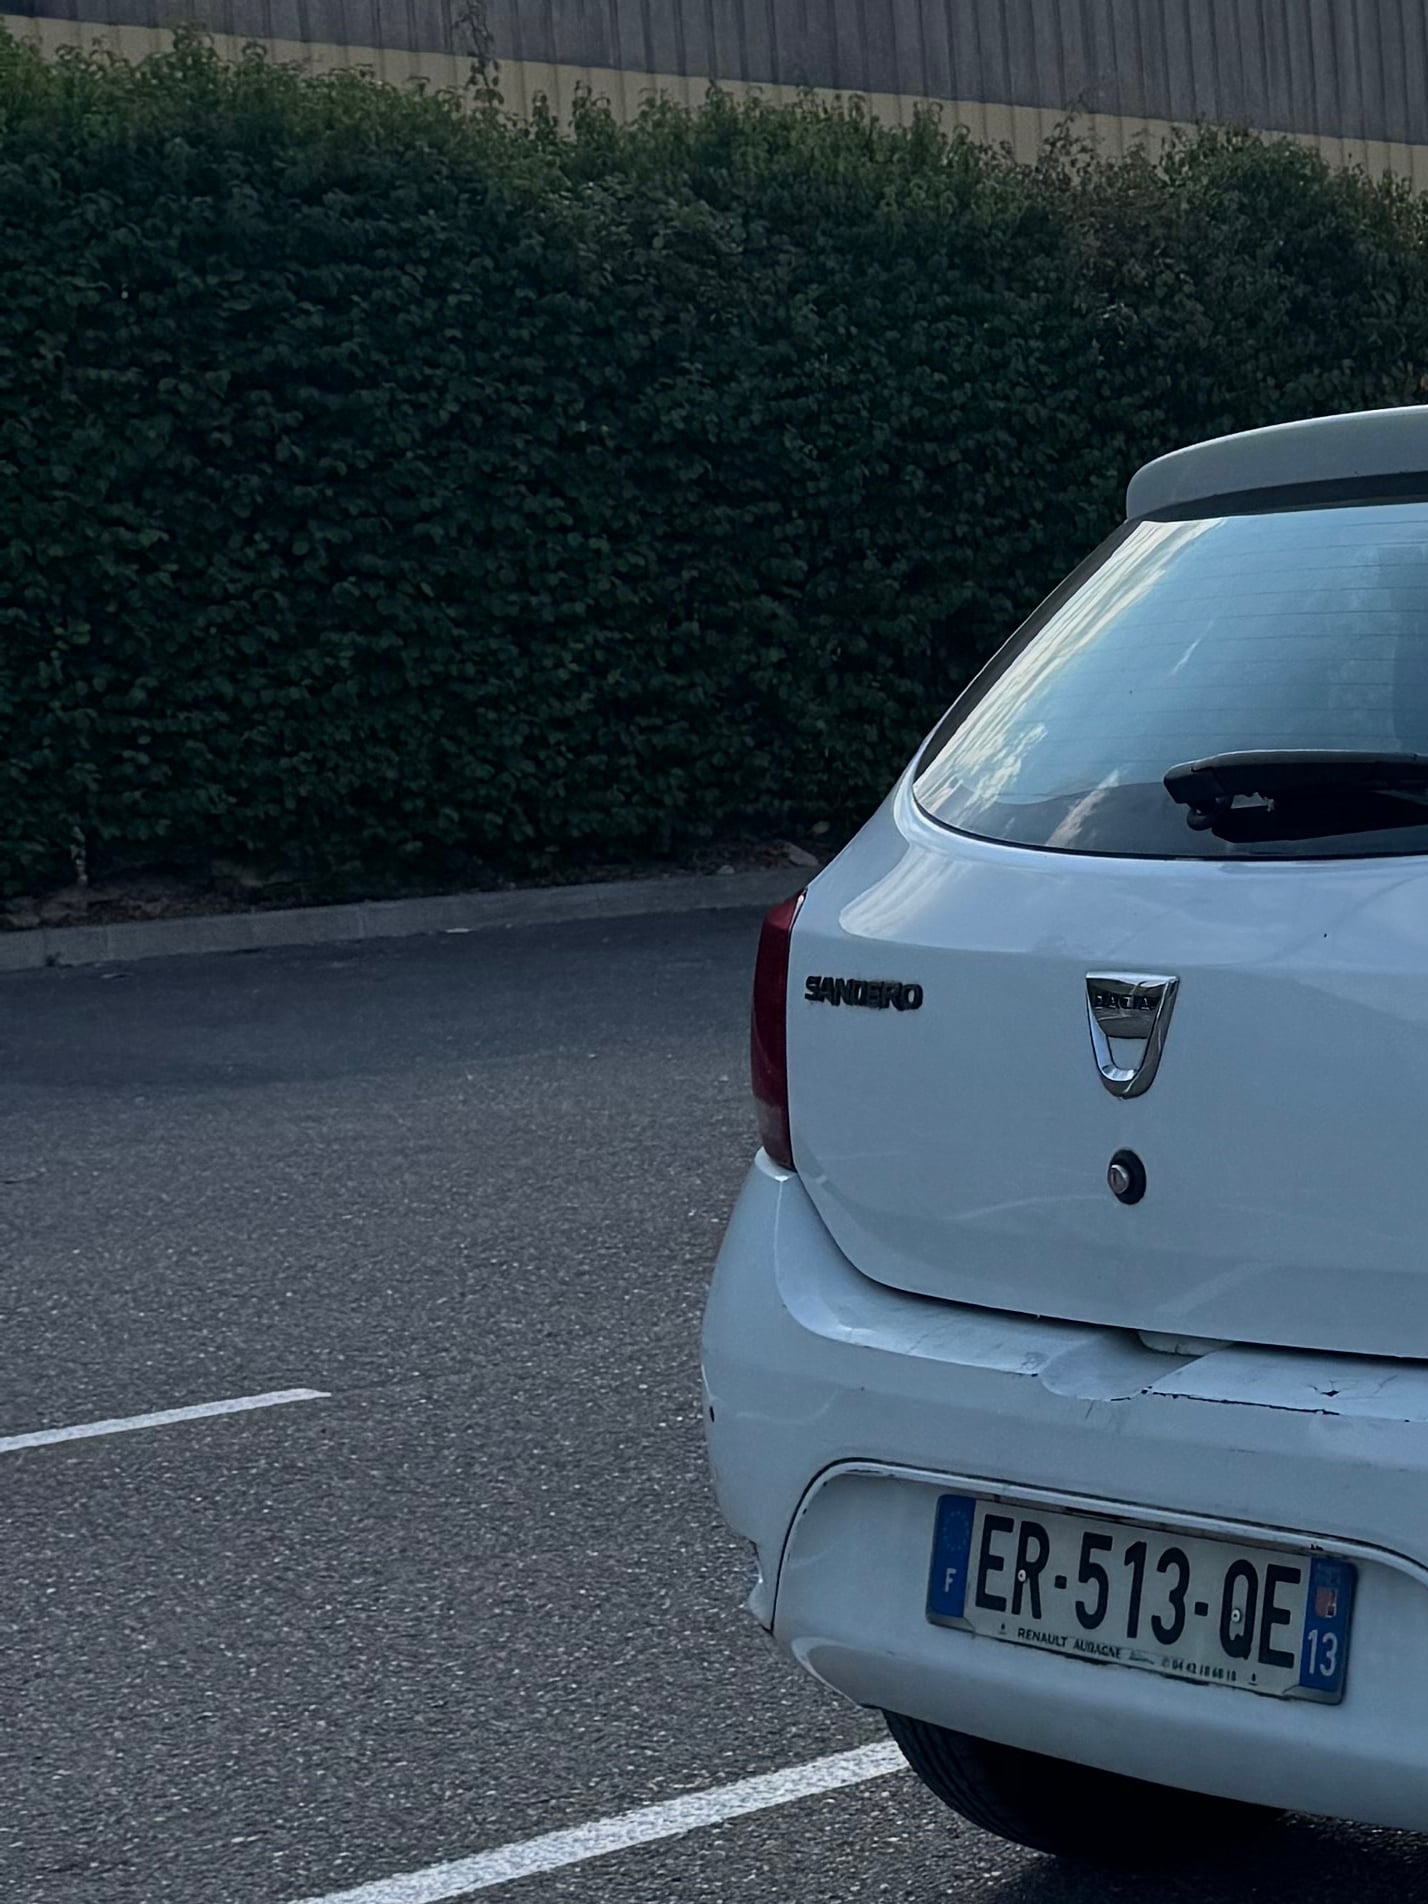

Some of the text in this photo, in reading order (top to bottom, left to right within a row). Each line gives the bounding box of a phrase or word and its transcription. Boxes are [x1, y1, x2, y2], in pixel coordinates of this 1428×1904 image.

[804, 975, 924, 1011] SANDERO
[943, 1567, 958, 1593] F
[974, 1513, 1302, 1669] ER-513-QE
[1017, 1627, 1068, 1647] RENAULT
[1307, 1629, 1339, 1677] 13
